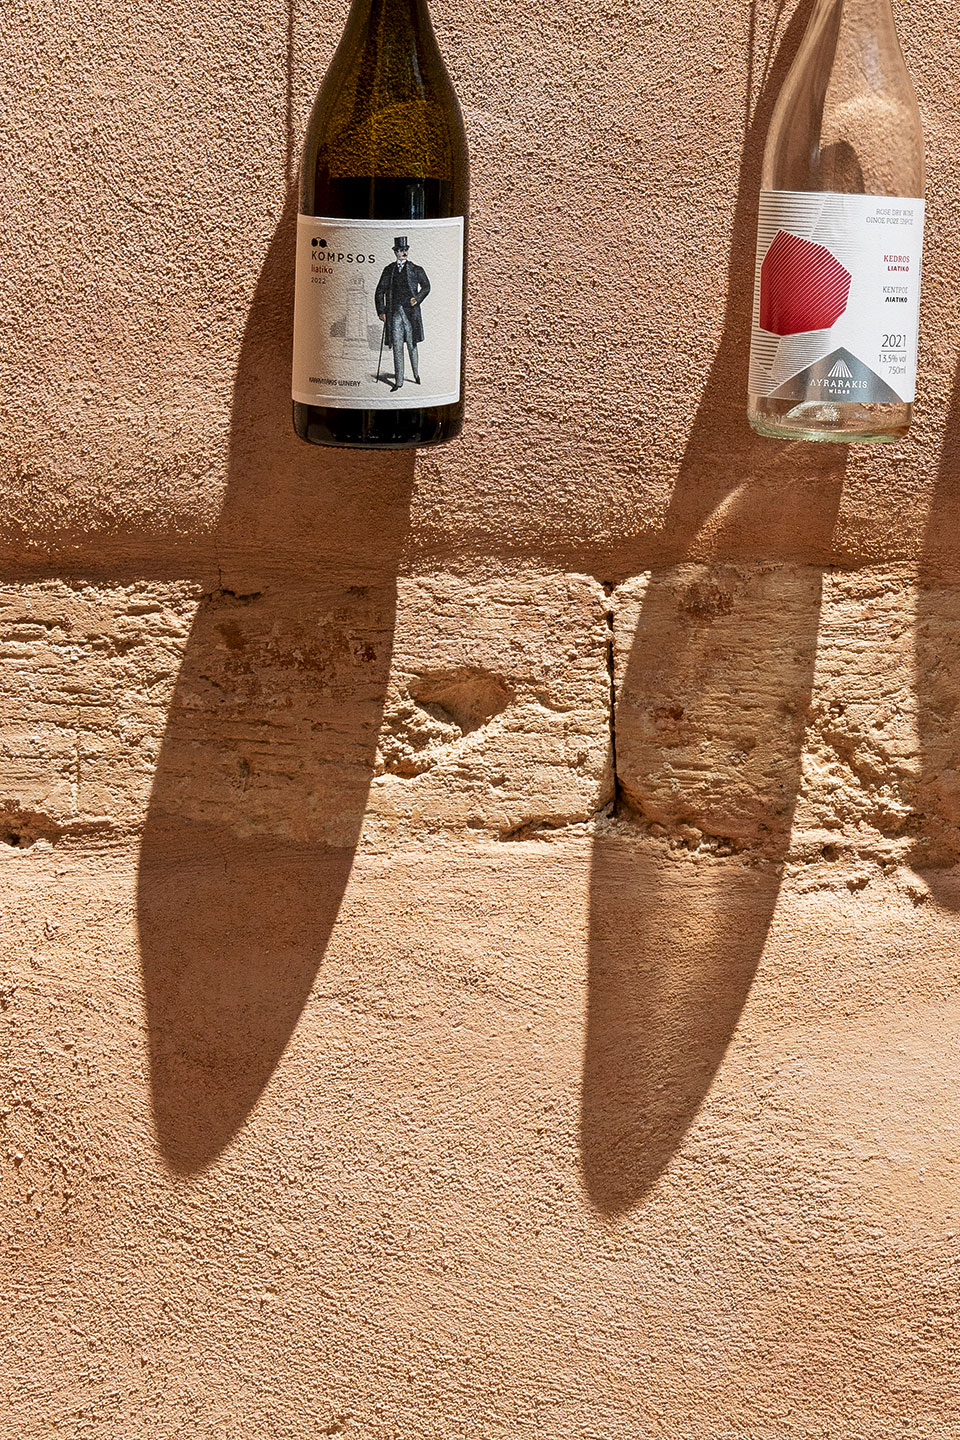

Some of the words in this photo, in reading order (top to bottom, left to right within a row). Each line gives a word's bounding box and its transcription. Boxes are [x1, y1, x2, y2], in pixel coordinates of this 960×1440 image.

[311, 251, 376, 264] KOMPSOS
[883, 254, 910, 263] KEDROS
[881, 334, 907, 348] 2021
